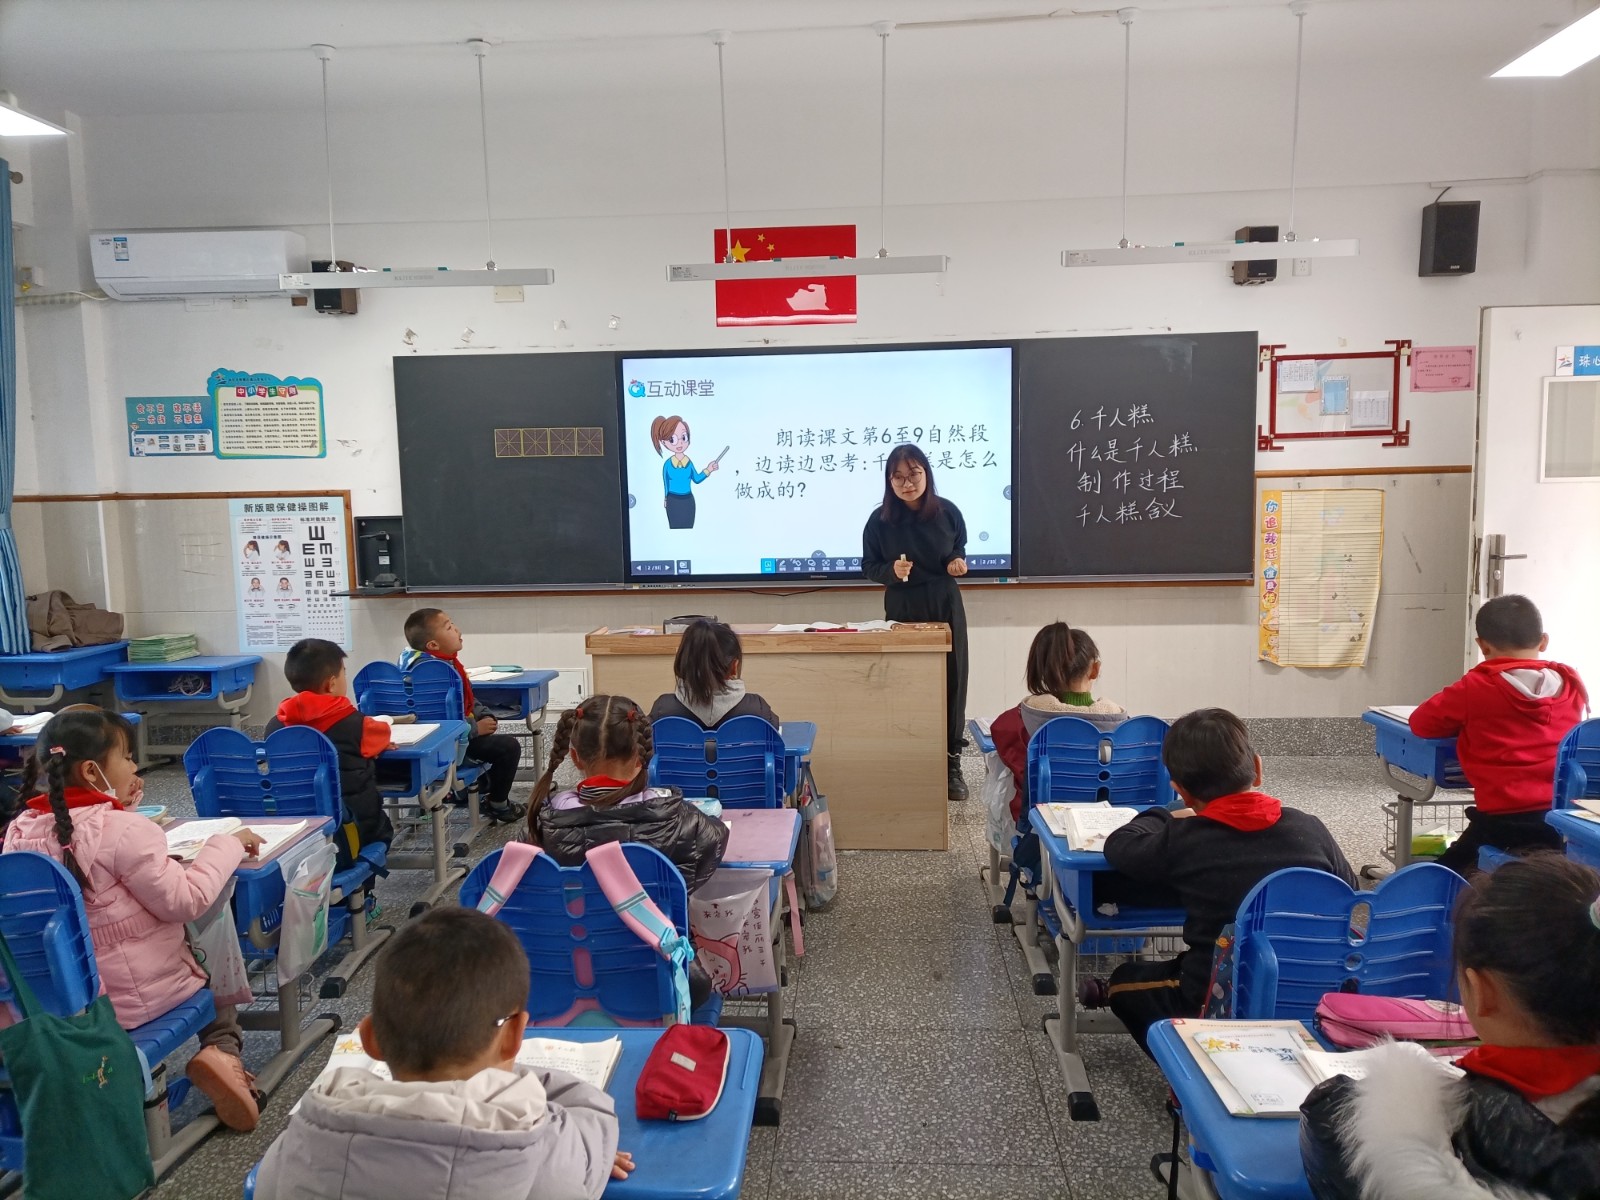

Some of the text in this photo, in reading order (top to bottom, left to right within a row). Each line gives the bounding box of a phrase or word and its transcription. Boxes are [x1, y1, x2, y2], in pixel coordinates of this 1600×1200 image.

[236, 385, 298, 398] 中小学生守则
[647, 379, 715, 398] 互动课堂
[1090, 403, 1155, 431] 千人糕
[776, 425, 990, 447] 朗读课文第6至9自然段
[1066, 431, 1198, 472] 什么是千人糕
[735, 479, 807, 500] 做成的？
[1076, 467, 1185, 494] 制作过程
[243, 501, 329, 513] 新版眼保健操图解
[1075, 496, 1183, 528] 千人糕含义
